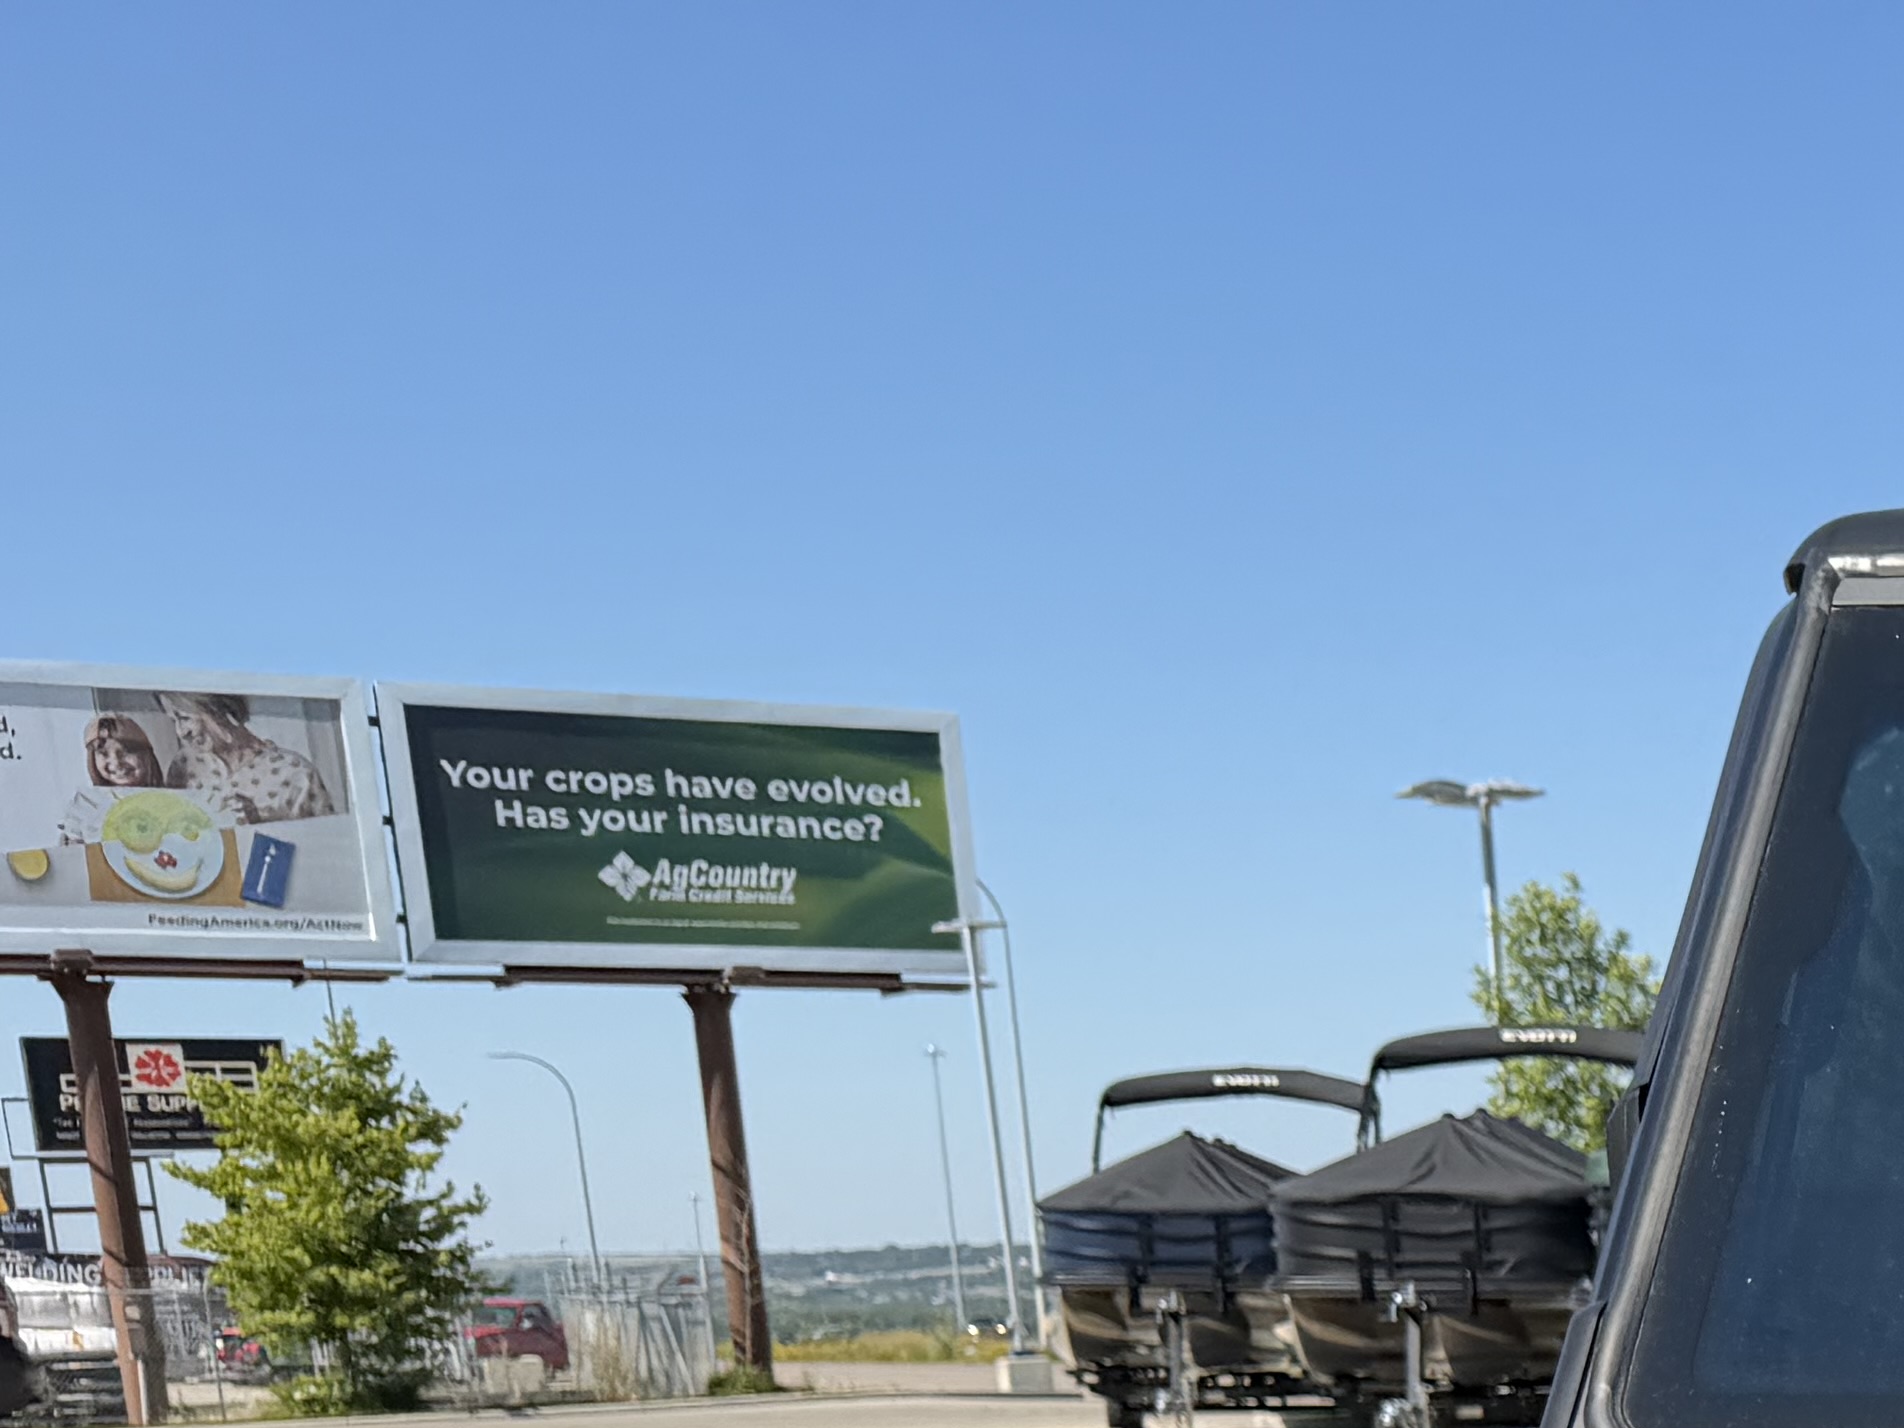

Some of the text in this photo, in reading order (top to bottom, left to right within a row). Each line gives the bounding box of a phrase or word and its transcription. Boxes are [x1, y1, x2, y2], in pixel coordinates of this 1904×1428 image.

[440, 759, 922, 808] Your crops have evolved.
[495, 799, 884, 842] Has your insurance?
[652, 857, 798, 894] AgCountry
